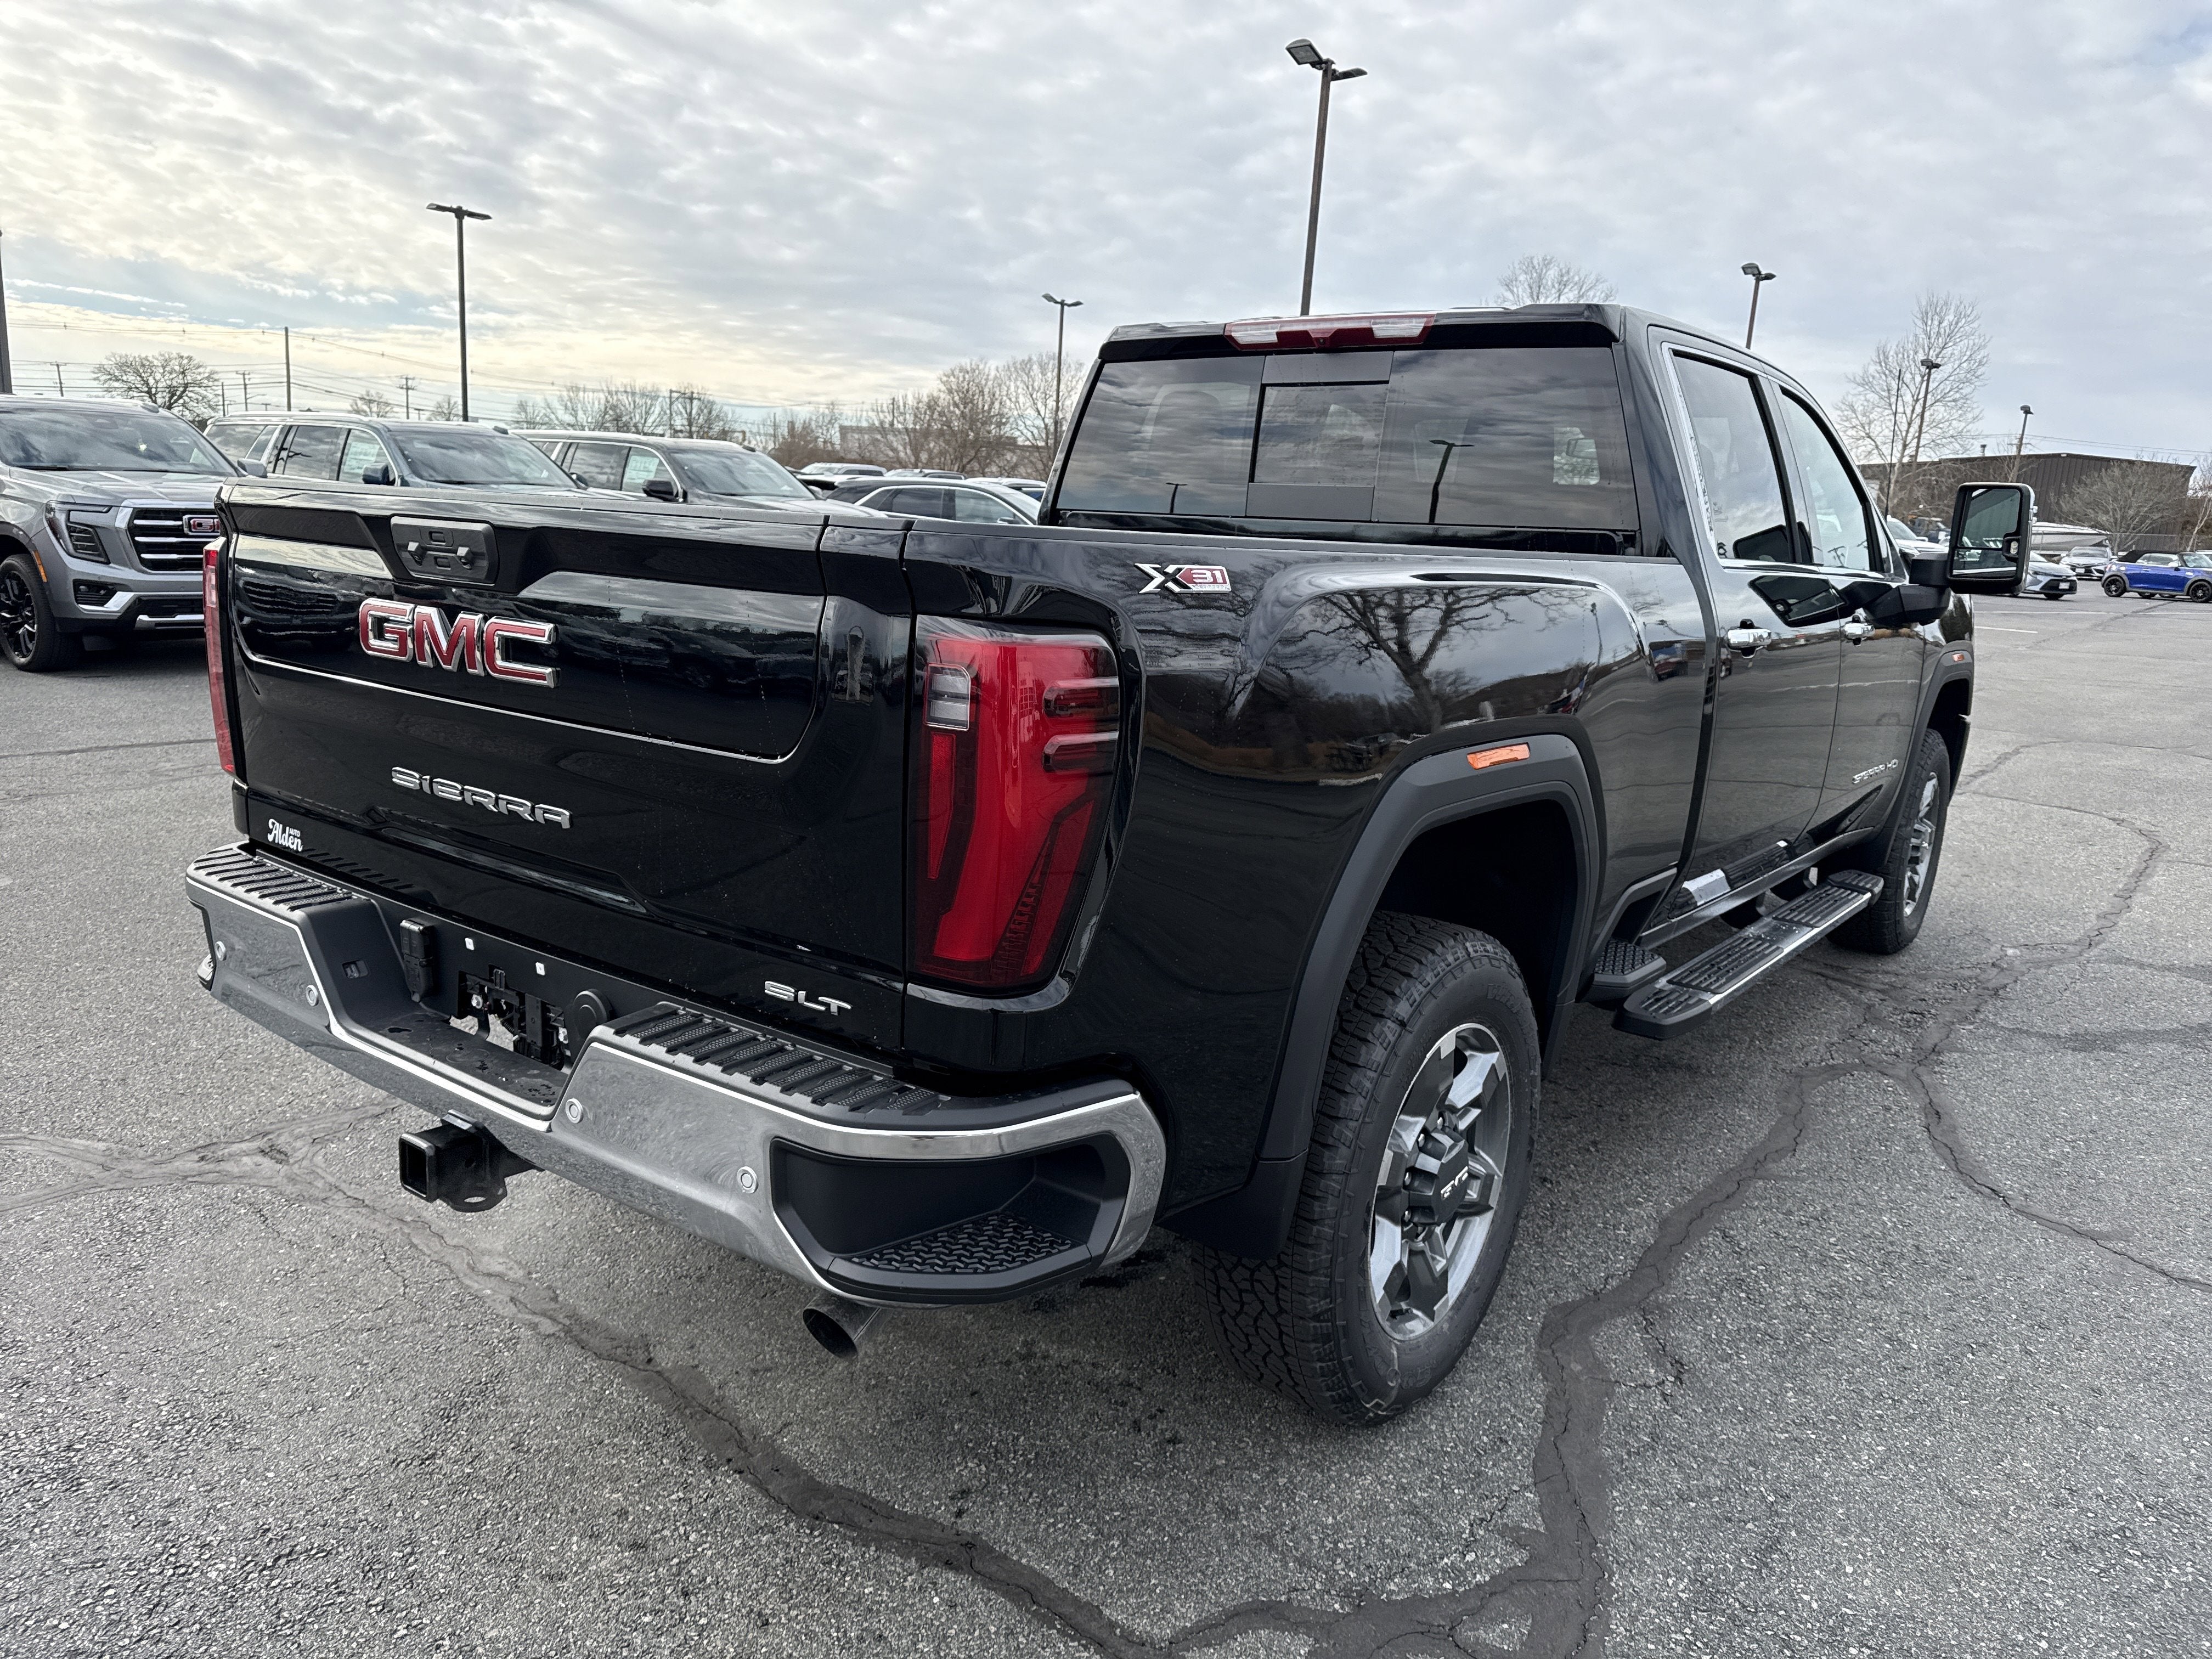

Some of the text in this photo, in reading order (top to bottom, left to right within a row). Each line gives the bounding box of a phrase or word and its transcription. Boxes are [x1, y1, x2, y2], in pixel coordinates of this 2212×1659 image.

[1133, 563, 1231, 594] X31
[359, 597, 559, 689] GMC
[392, 766, 571, 829] SIERRA
[267, 819, 303, 851] Alden
[289, 827, 301, 837] AUTO
[764, 980, 851, 1015] SLT
